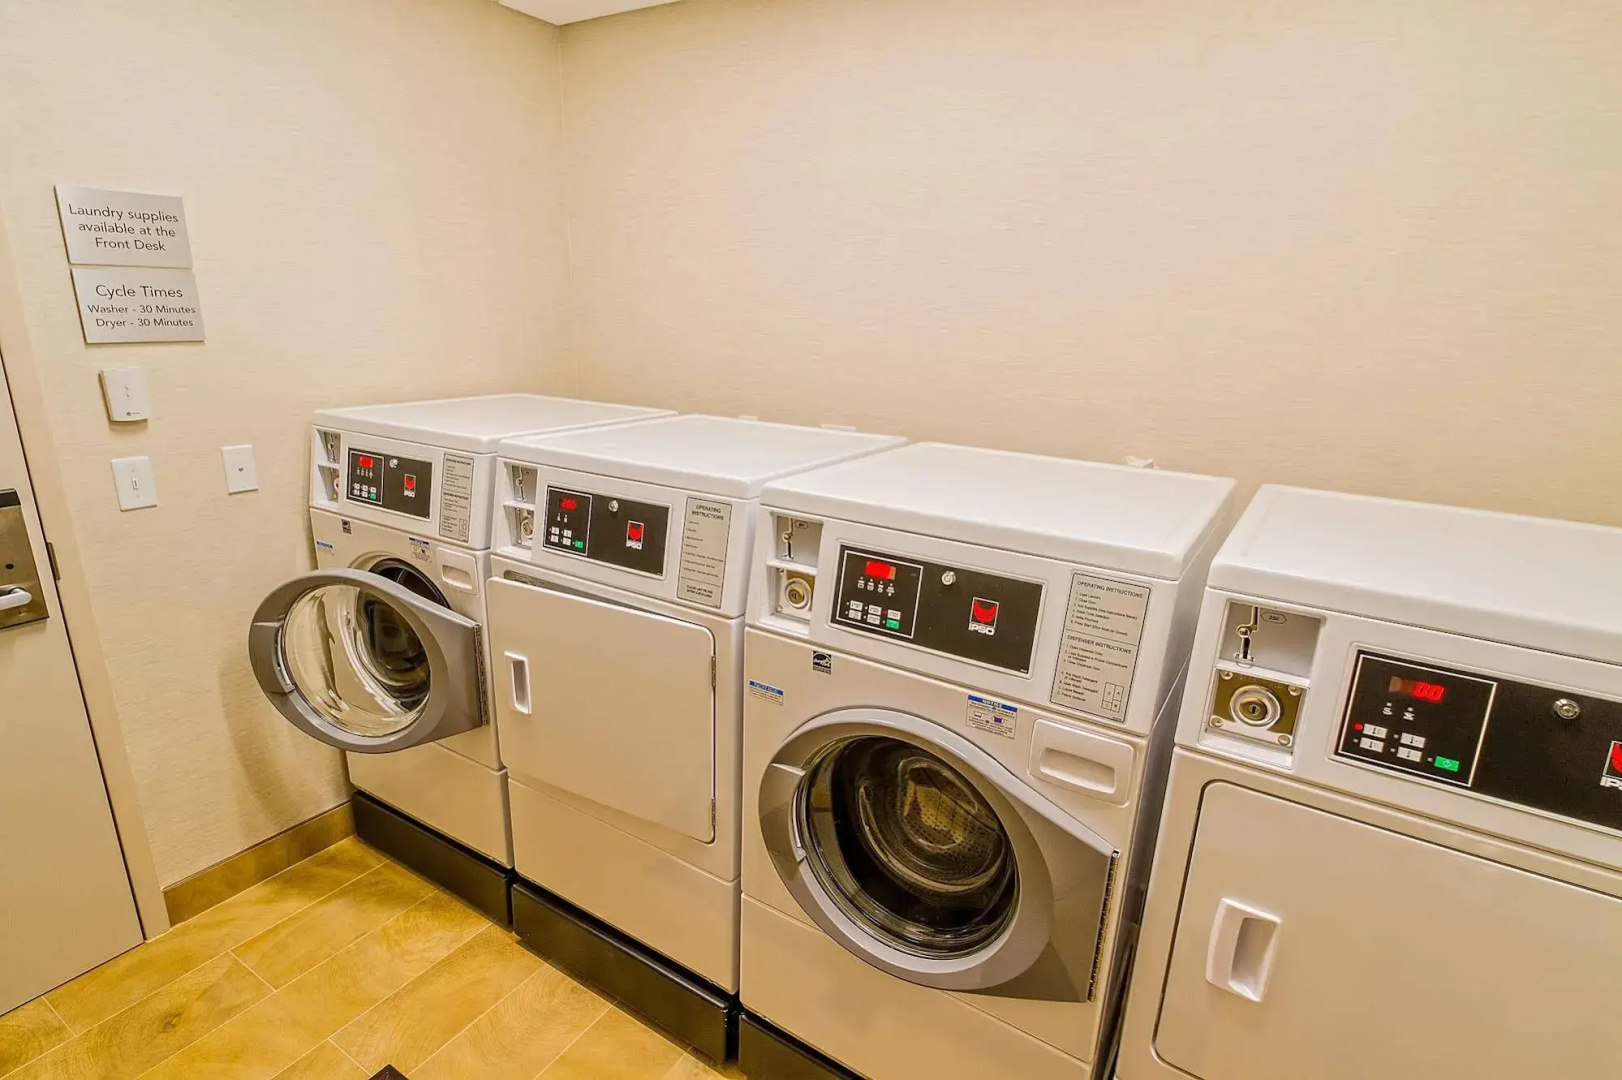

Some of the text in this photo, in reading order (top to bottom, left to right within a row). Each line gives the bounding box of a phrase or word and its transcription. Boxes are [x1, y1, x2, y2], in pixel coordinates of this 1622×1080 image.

[68, 203, 178, 224] Laundry supplies
[78, 222, 176, 237] available at the
[95, 237, 166, 252] Front Desk
[96, 284, 183, 300] Cycle Times
[88, 304, 128, 314] Washer
[140, 304, 152, 314] 30
[156, 305, 196, 314] Minutes
[96, 318, 127, 328] Dryer
[138, 318, 150, 327] 30
[154, 318, 194, 327] Minutes
[626, 540, 642, 550] IPSO
[1076, 581, 1143, 598] OPERATING INSTRUCTIONS
[968, 623, 995, 635] IPSO
[1067, 635, 1131, 654] DISPENSER INSTRUCTIONS
